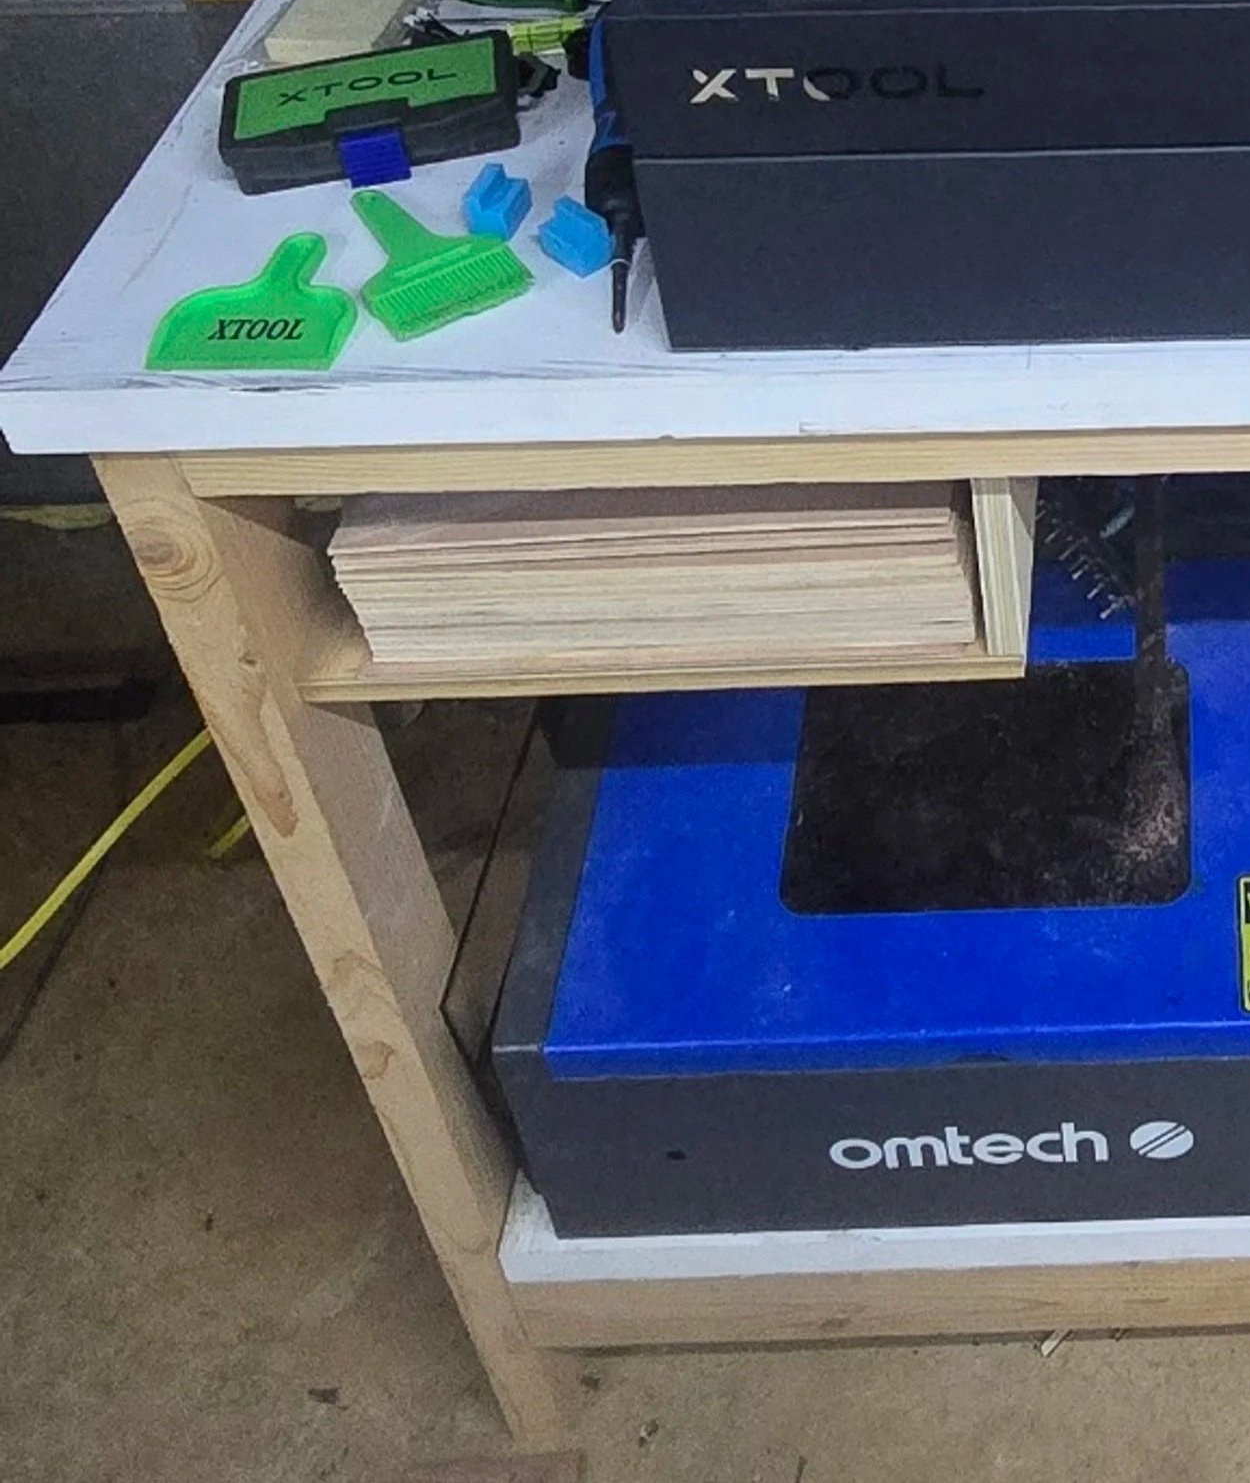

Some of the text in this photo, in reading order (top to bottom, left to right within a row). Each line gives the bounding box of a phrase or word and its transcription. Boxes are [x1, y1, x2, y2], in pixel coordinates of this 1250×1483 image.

[278, 67, 458, 107] XTOOL
[689, 67, 986, 104] XTOOL
[207, 318, 306, 342] XTOOL
[828, 1121, 1110, 1170] omtech
